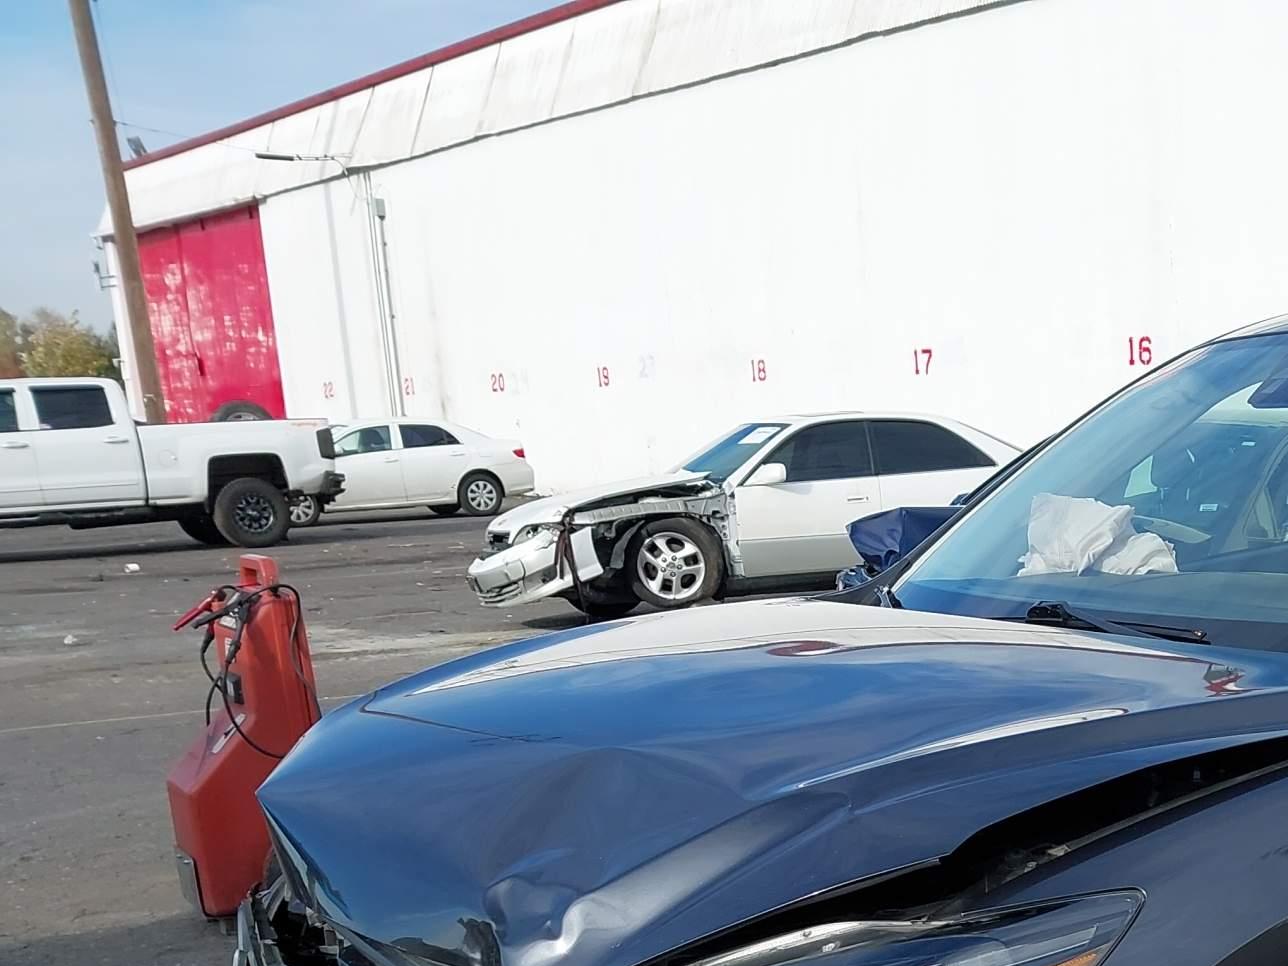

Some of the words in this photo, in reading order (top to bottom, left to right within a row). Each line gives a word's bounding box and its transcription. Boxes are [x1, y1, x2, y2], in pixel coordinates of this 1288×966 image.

[913, 347, 934, 375] 17
[1127, 335, 1153, 366] 16
[596, 366, 611, 388] 19
[750, 358, 768, 383] 18
[323, 381, 335, 399] 22
[404, 377, 416, 396] 21
[490, 373, 506, 393] 20
